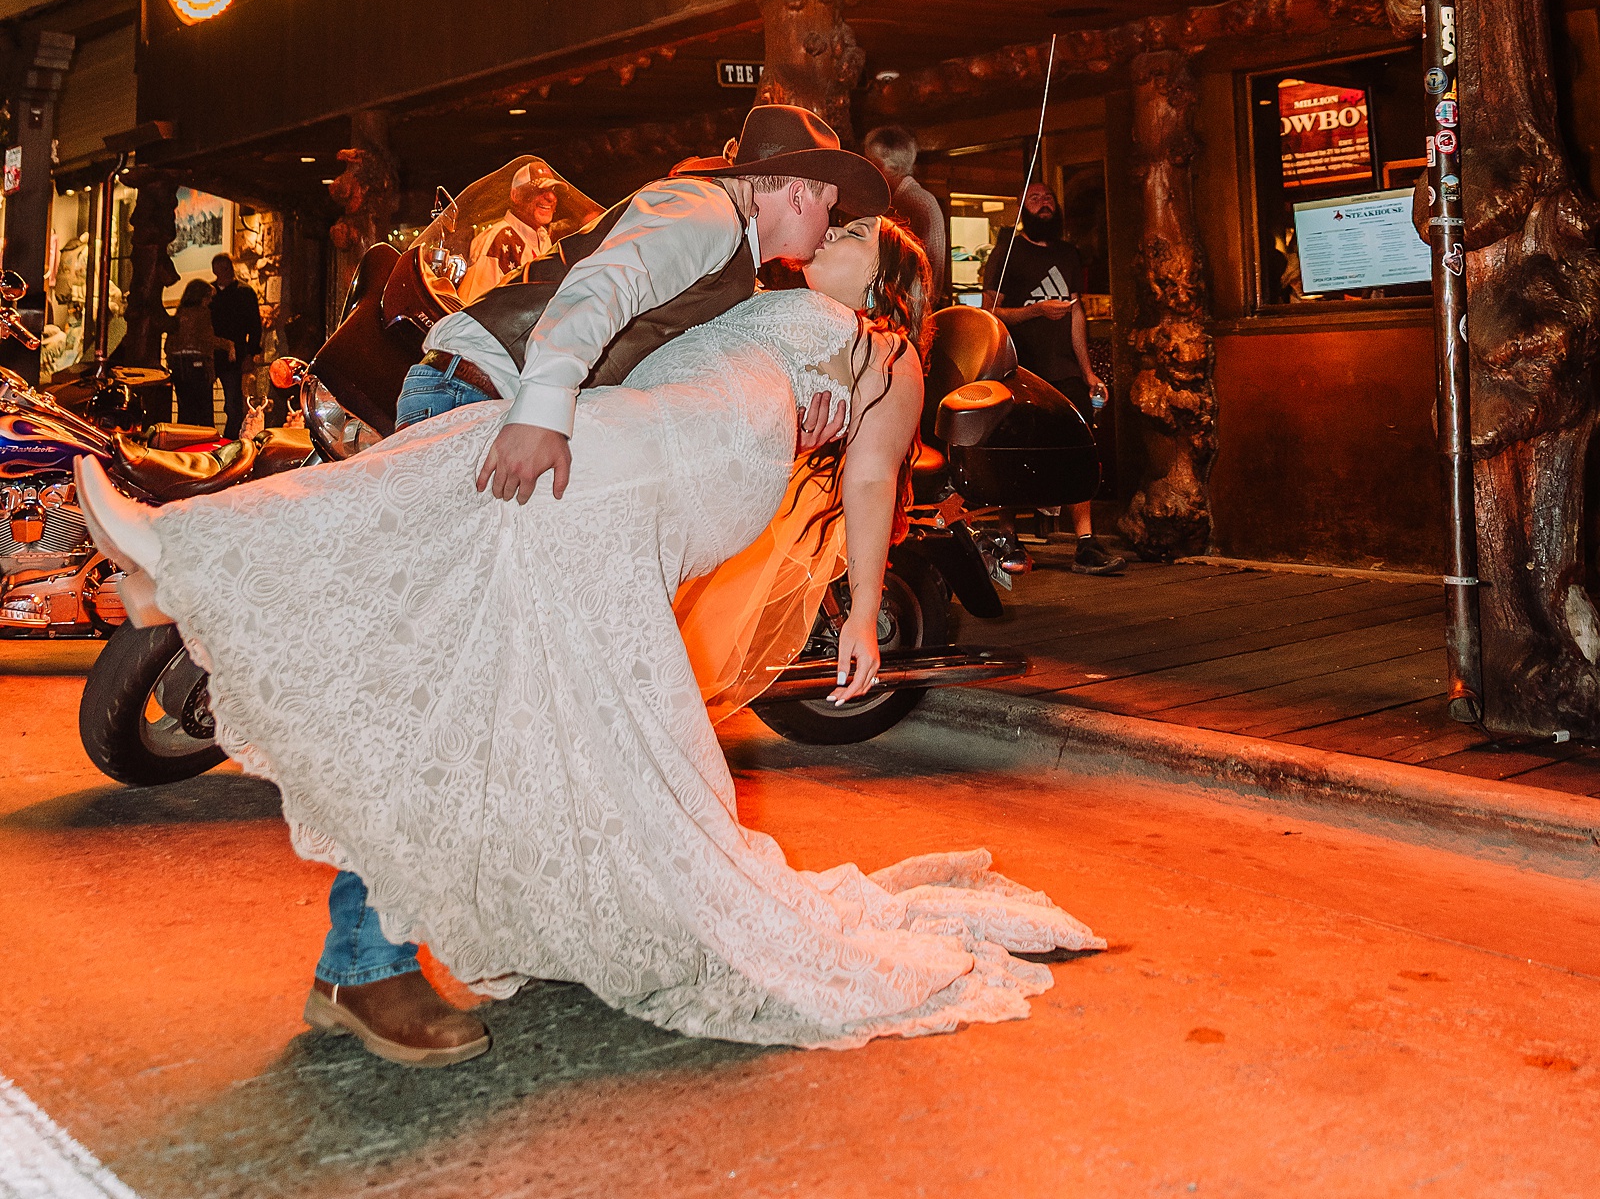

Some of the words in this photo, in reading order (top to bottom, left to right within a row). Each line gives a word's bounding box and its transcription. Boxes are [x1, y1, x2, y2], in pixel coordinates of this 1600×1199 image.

[725, 64, 754, 83] THE
[1294, 95, 1339, 109] MILLION
[1345, 207, 1404, 219] STEAKHOUSE
